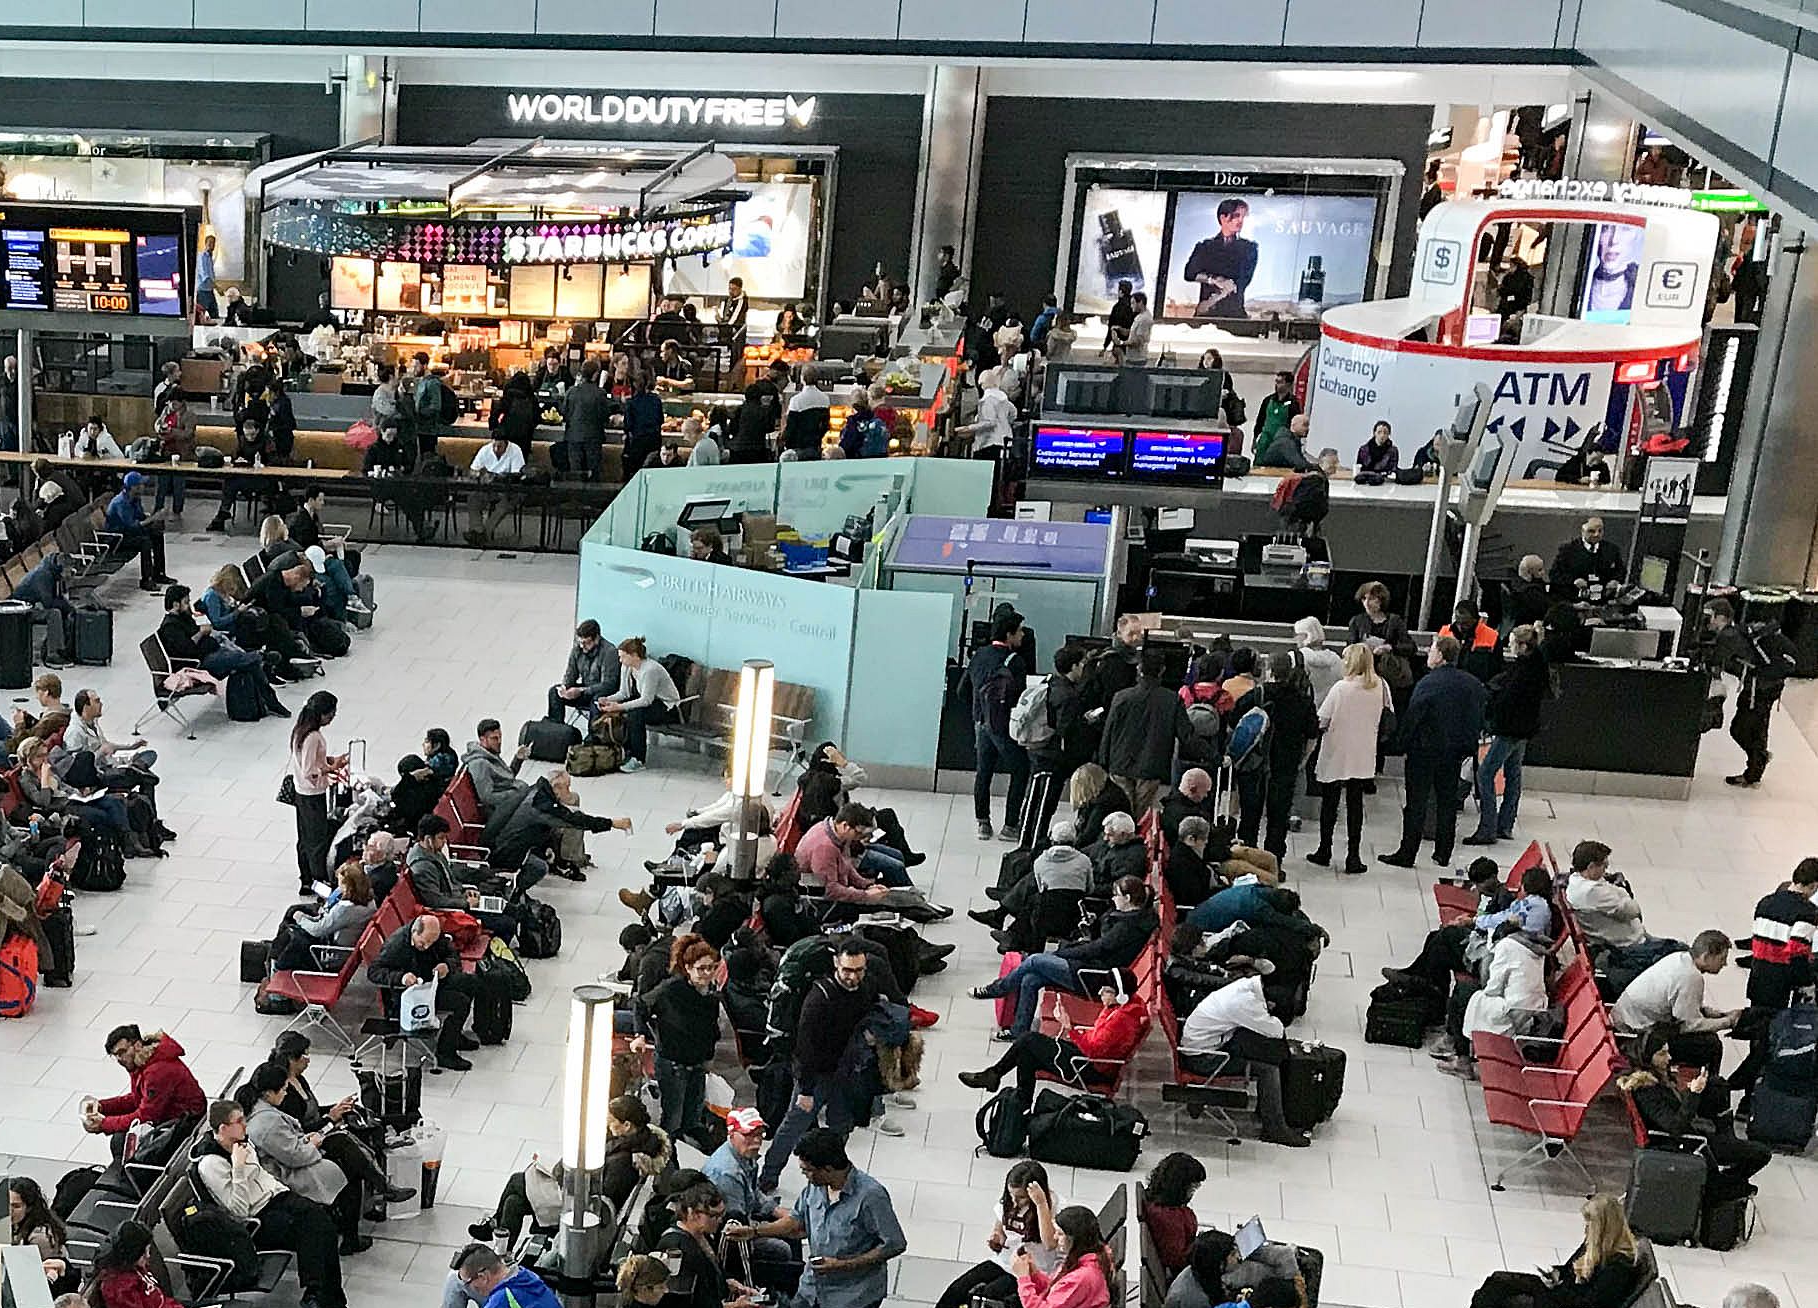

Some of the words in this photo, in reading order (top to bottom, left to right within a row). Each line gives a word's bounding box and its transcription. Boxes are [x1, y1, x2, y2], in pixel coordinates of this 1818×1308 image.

[1214, 172, 1249, 186] Dior
[1275, 221, 1365, 235] SAUVAGE
[509, 231, 667, 261] STARBUCKS
[94, 296, 128, 310] 10:00
[1322, 345, 1380, 382] Currency
[1319, 372, 1377, 406] Exchange
[1493, 371, 1591, 406] ATM
[1036, 449, 1068, 458] Customer
[1135, 454, 1166, 462] Customer
[661, 574, 720, 597] BRITISH
[720, 585, 787, 609] AIRWAYS
